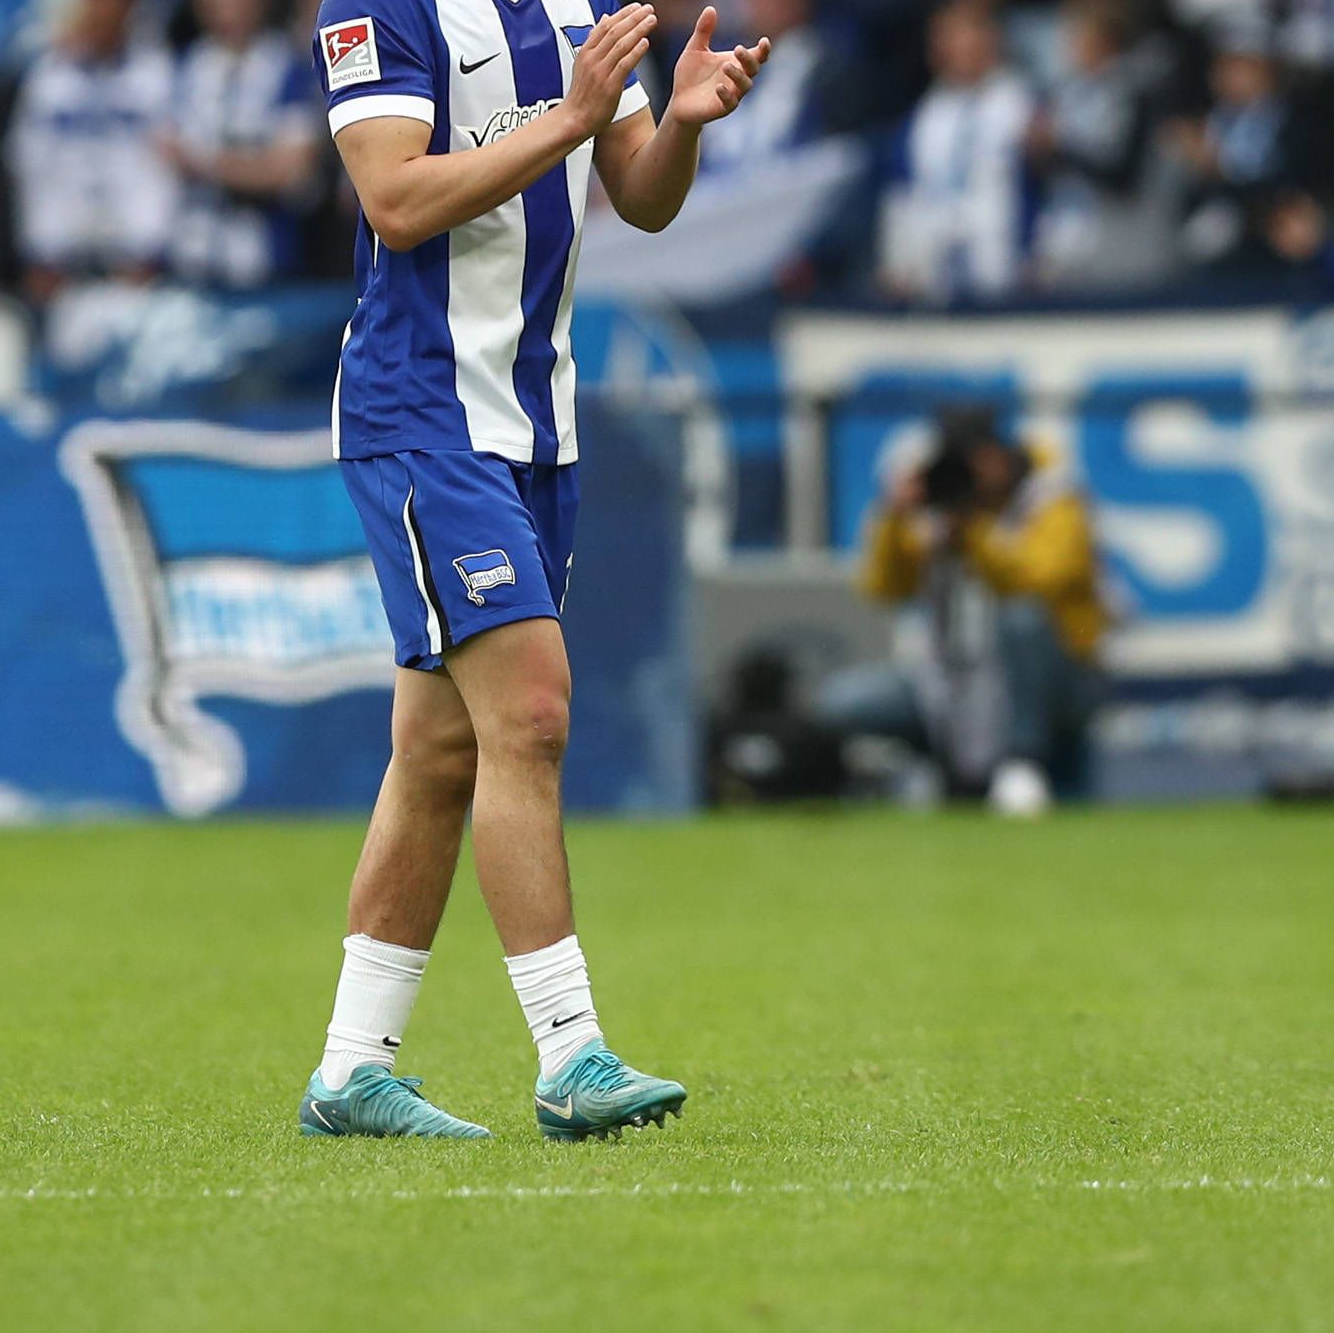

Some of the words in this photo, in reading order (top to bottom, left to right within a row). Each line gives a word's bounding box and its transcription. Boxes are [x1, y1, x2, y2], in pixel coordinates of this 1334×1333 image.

[354, 46, 369, 64] 2
[470, 573, 495, 585] Hertha
[495, 567, 511, 580] BSC
